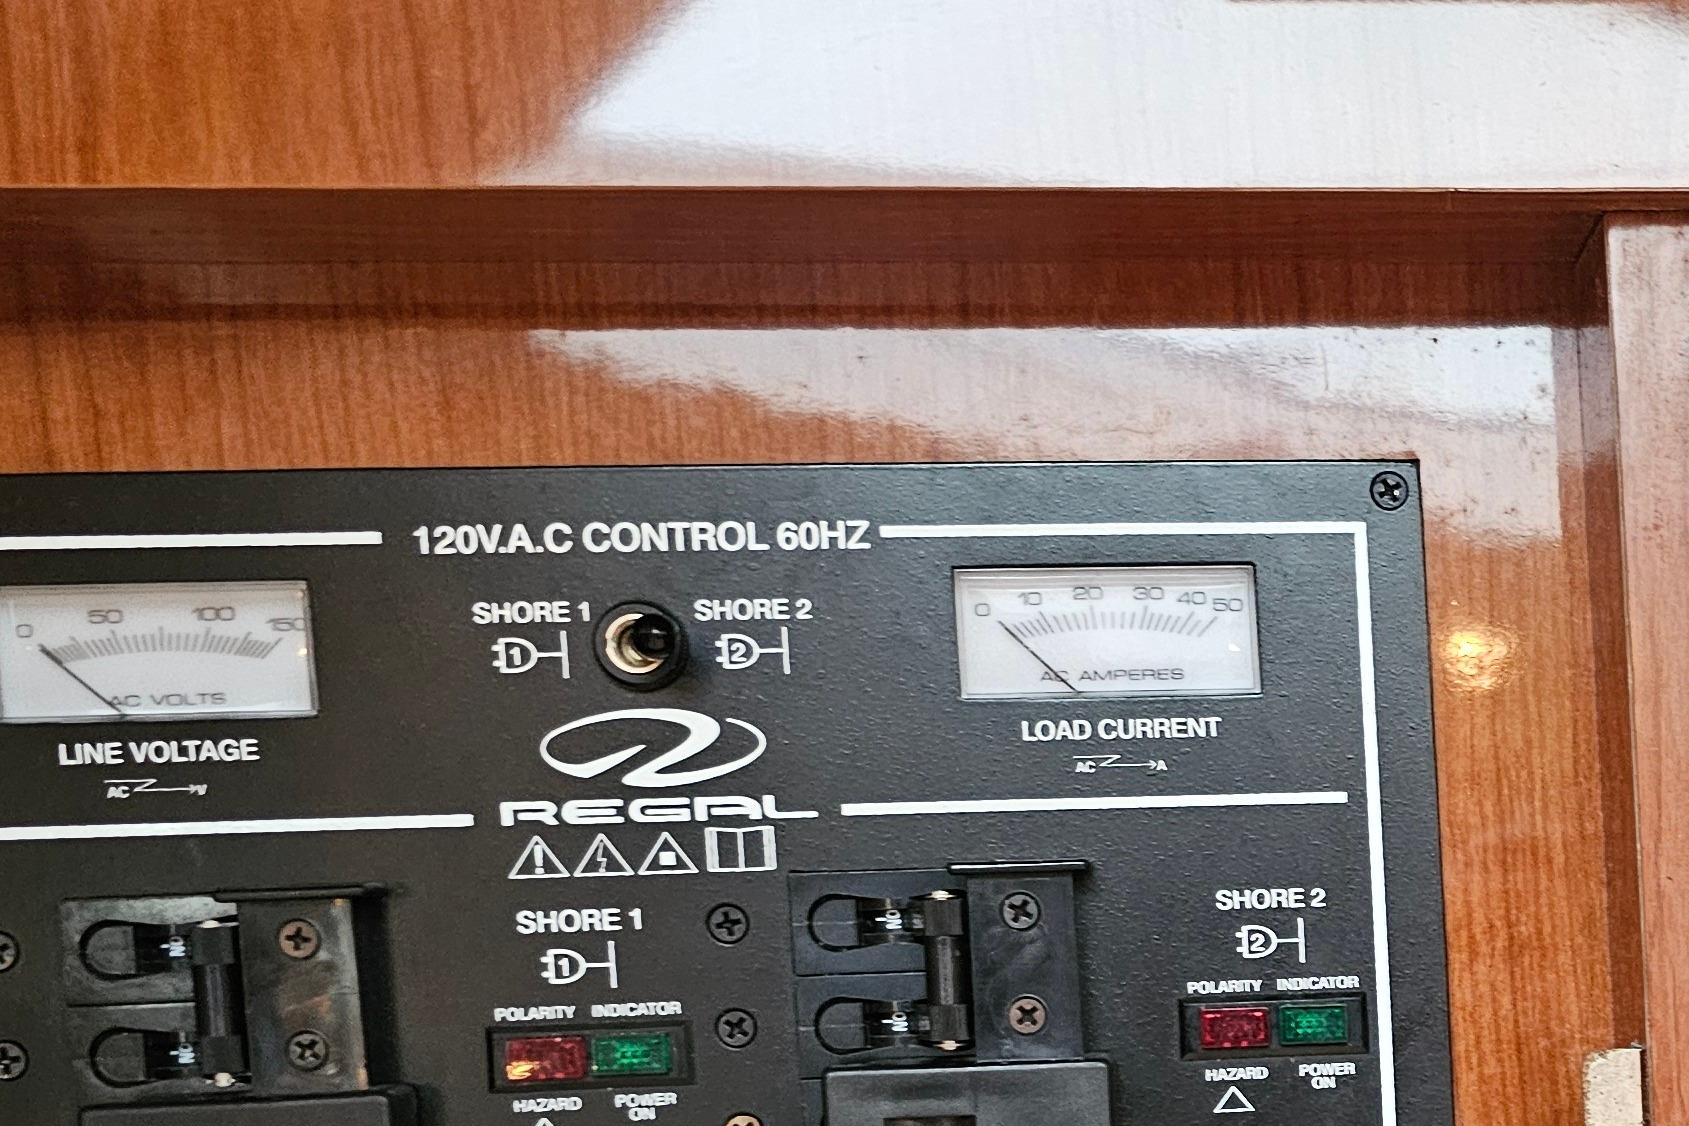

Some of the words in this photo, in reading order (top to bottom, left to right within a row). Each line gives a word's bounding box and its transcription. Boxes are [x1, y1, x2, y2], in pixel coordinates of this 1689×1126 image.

[412, 522, 573, 555] 120V.A.C
[582, 521, 770, 553] CONTROL
[776, 520, 871, 551] 60HZ
[1019, 592, 1042, 606] 10
[1072, 586, 1104, 601] 20
[1132, 586, 1164, 601] 30
[1176, 590, 1206, 605] 40
[472, 601, 572, 625] SHORE
[577, 601, 591, 622] 1
[693, 599, 791, 622] SHORE
[796, 599, 813, 620] 2
[975, 602, 990, 617] 0
[1212, 598, 1243, 613] 50
[87, 608, 123, 624] 50
[191, 607, 236, 622] 100
[15, 624, 33, 638] 0
[1040, 668, 1069, 682] AC
[1079, 666, 1185, 682] AMPERES
[111, 694, 140, 708] AC
[150, 692, 227, 707] VOLTS
[1021, 719, 1093, 742] LOAD
[1098, 716, 1222, 740] CURRENT
[58, 741, 125, 766] LINE
[130, 738, 261, 763] VOLTAGE
[500, 795, 819, 828] REGAL
[1215, 887, 1306, 912] SHORE
[1309, 887, 1327, 908] 2
[516, 908, 623, 935] SHORE
[628, 908, 643, 930] 1
[1186, 979, 1263, 995] POLARITY
[1276, 974, 1360, 992] INDICATOR
[494, 1005, 576, 1022] POLARITY
[591, 1001, 682, 1018] INDICATOR
[1204, 1066, 1269, 1082] HAZARD
[1299, 1062, 1356, 1078] POWER
[1311, 1075, 1337, 1090] ON
[512, 1096, 583, 1113] HAZARD
[614, 1092, 678, 1109] POWER
[628, 1106, 657, 1122] ON
